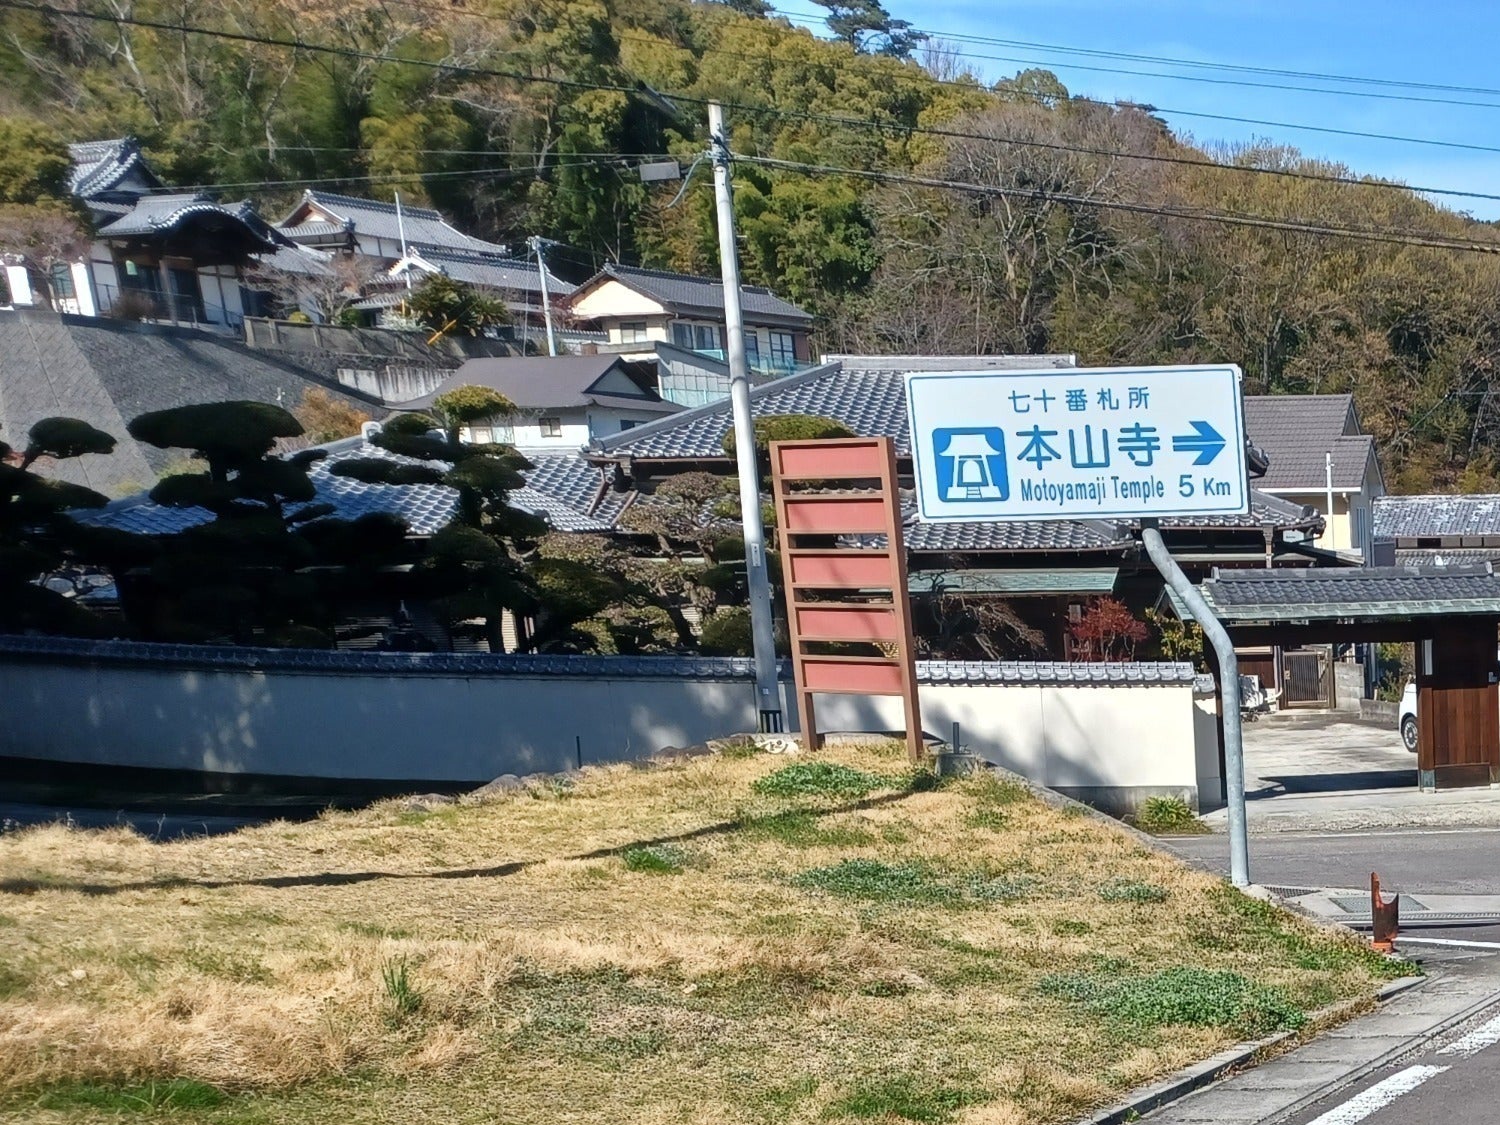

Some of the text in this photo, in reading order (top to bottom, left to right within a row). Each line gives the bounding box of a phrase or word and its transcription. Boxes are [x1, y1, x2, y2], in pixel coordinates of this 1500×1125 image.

[1008, 386, 1150, 413] 七十番札所
[1016, 422, 1161, 471] 本山寺
[1020, 474, 1231, 506] Motoyamaji Temple 5 Km
